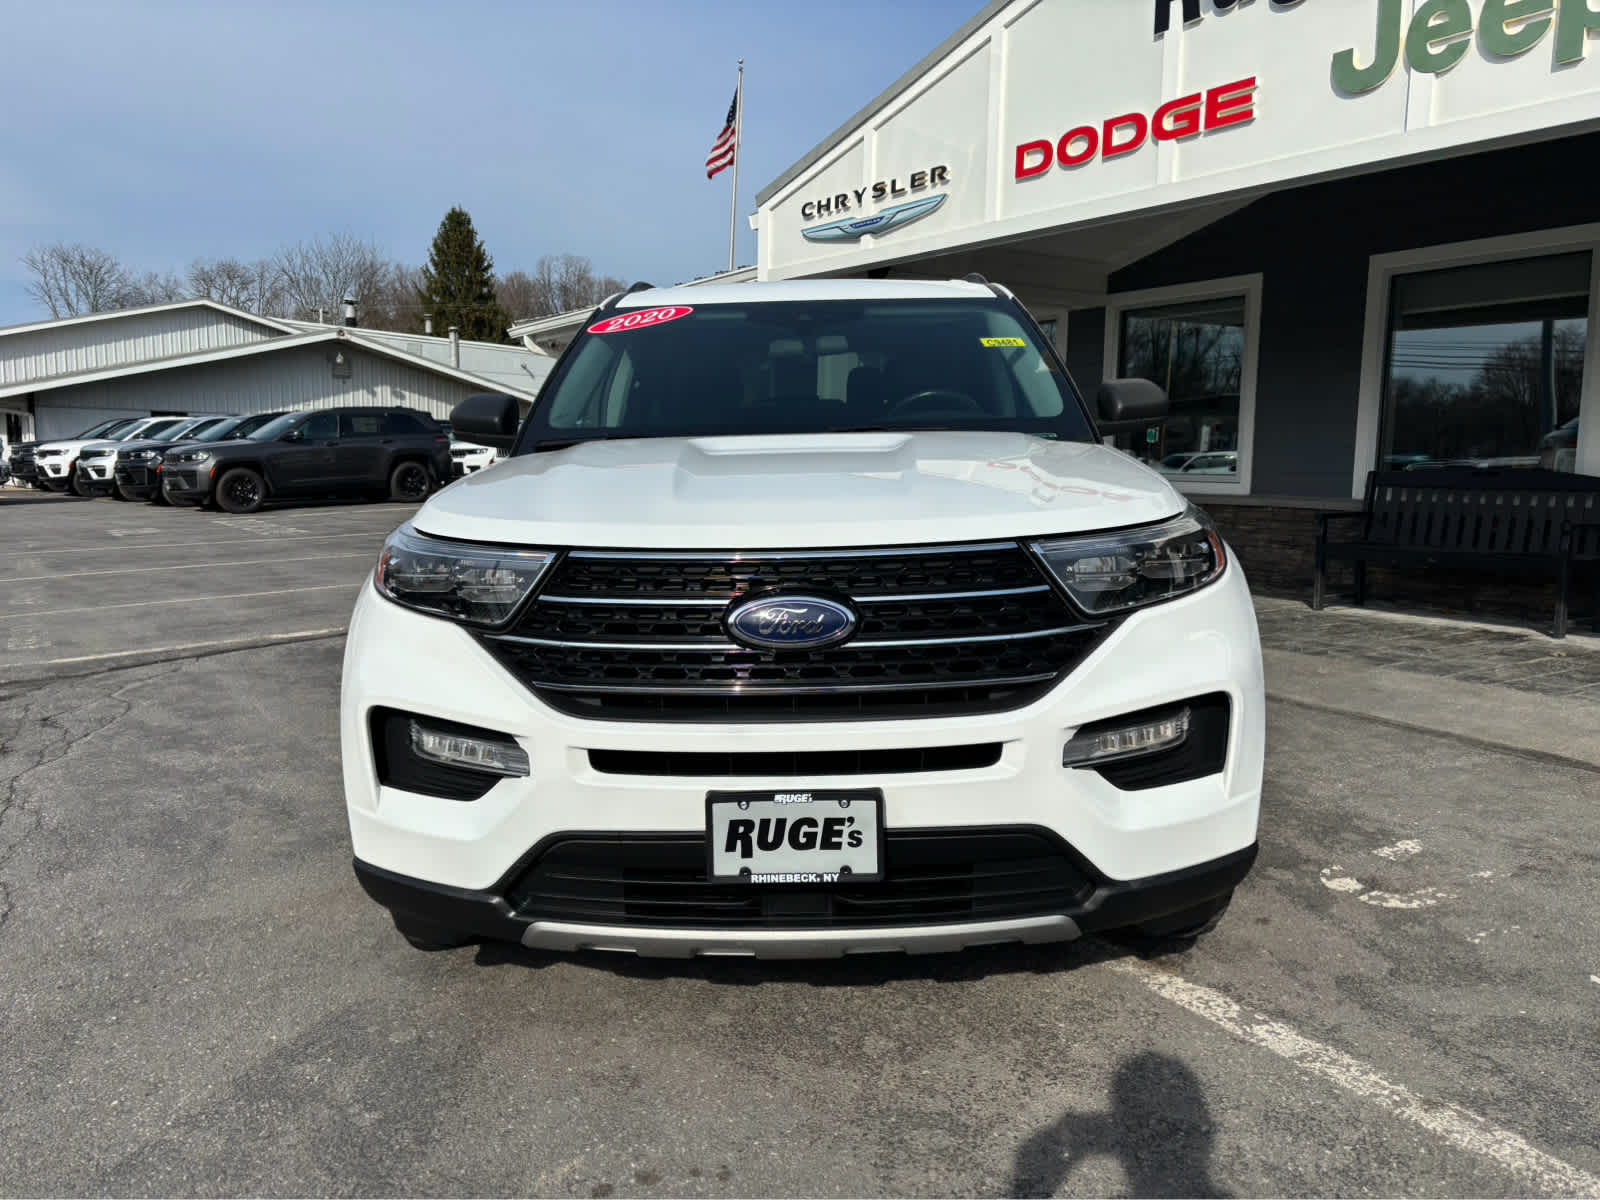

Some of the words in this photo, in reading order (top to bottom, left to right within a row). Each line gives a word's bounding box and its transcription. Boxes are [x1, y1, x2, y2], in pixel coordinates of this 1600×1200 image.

[1015, 76, 1256, 181] DODGE
[801, 165, 949, 218] CHRYSLER
[606, 308, 676, 331] 2020
[757, 607, 825, 635] Ford
[823, 873, 839, 883] NY
